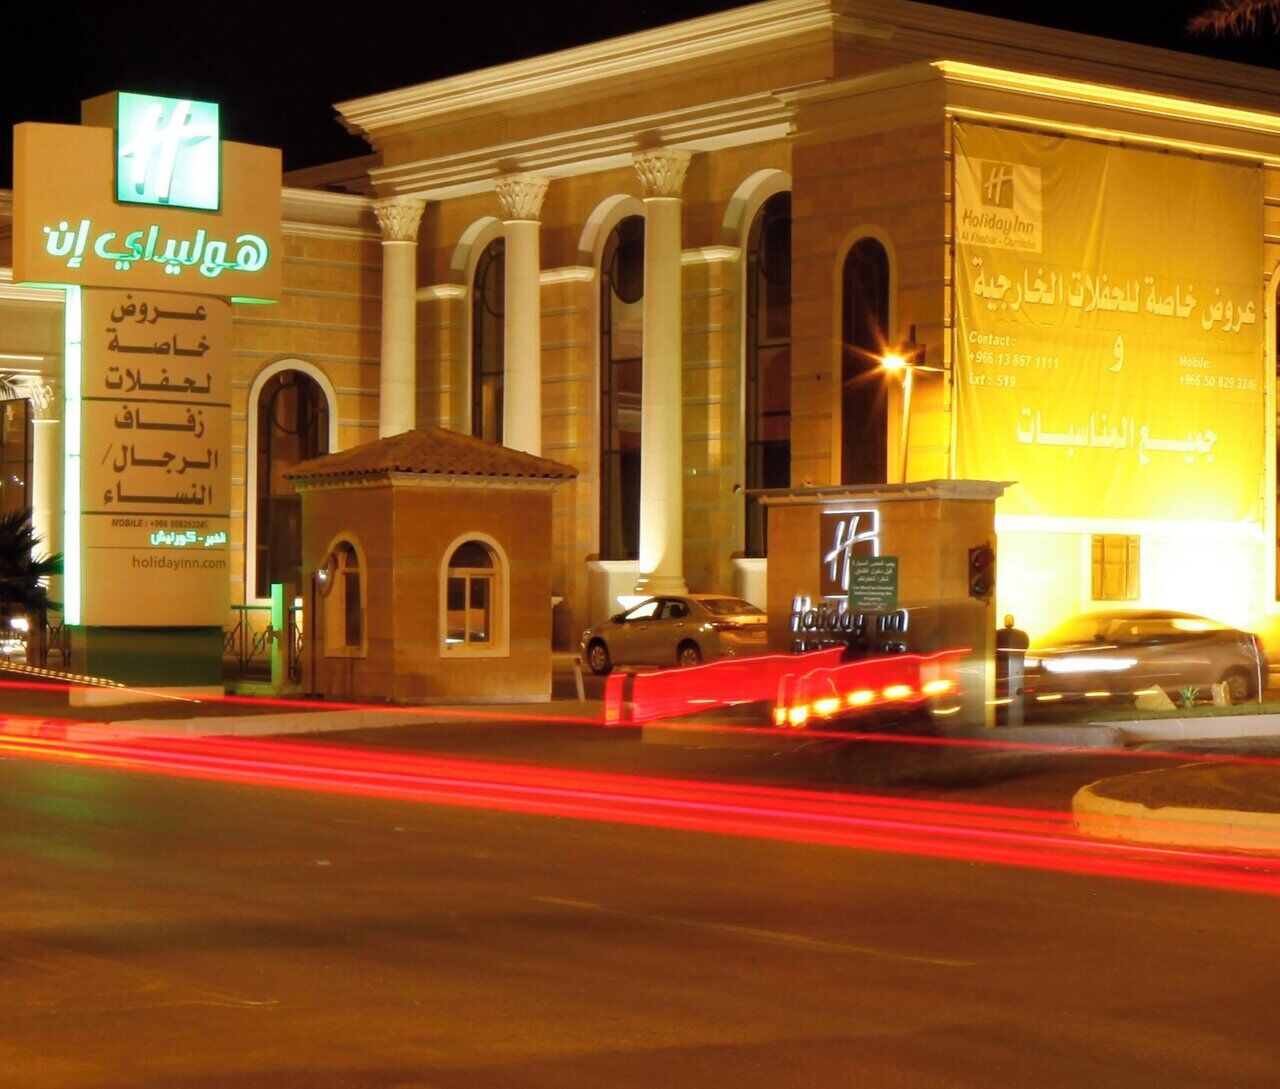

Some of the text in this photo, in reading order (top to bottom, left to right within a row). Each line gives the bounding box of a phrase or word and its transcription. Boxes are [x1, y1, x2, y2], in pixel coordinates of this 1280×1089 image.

[963, 208, 1034, 235] Holiday Inn
[43, 220, 269, 278] هوليداي إن
[961, 231, 969, 240] Al
[971, 233, 997, 244] Khobar
[1004, 236, 1037, 249] Corniche
[972, 256, 1256, 333] عروض خاصة للحفلات الخارجية
[111, 294, 208, 324] عروض
[106, 328, 210, 357] خاصة
[969, 331, 1010, 346] Contact
[969, 351, 1058, 369] +966 13 867 1111
[1109, 333, 1125, 372] و
[1179, 355, 1212, 368] Mobile:
[105, 366, 212, 395] لحفلات
[969, 372, 986, 385] Ext
[996, 375, 1016, 387] 519
[1179, 374, 1201, 386] +966
[1204, 376, 1215, 387] 50
[114, 405, 205, 438] زفاف
[1016, 406, 1218, 466] جميع المناسبات
[104, 481, 212, 505] النساء
[111, 519, 143, 527] MOBILE
[132, 556, 226, 571] holidayinn.com
